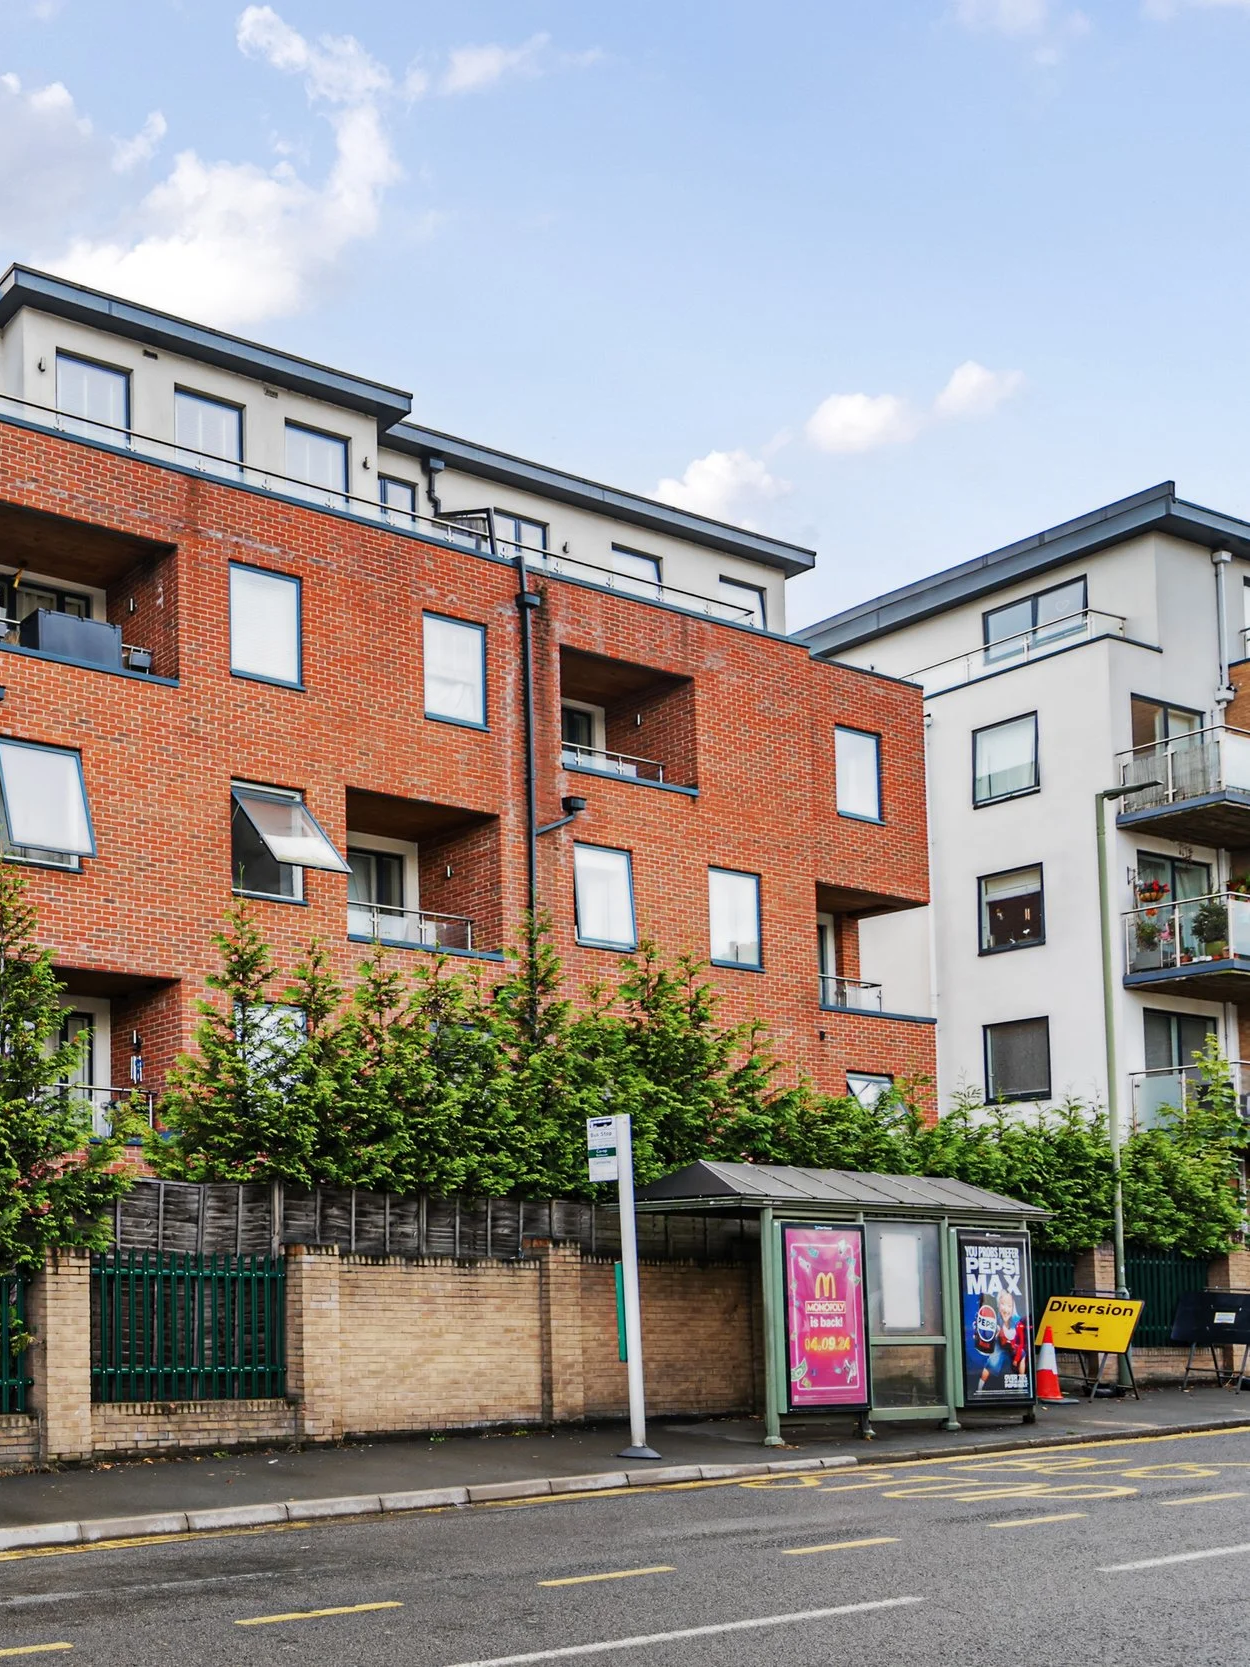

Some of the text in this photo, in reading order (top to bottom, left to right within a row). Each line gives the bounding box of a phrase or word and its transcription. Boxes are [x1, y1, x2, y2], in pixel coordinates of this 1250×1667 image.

[964, 1246, 977, 1257] YOU
[965, 1257, 1020, 1275] PEPSI
[966, 1274, 1022, 1296] MAX
[806, 1302, 845, 1312] MONOPOLY
[1049, 1300, 1134, 1317] Diversion
[810, 1316, 843, 1328] is back!
[805, 1336, 851, 1351] 04.09.24
[948, 1456, 1250, 1478] BUS
[739, 1474, 1139, 1501] STOP
